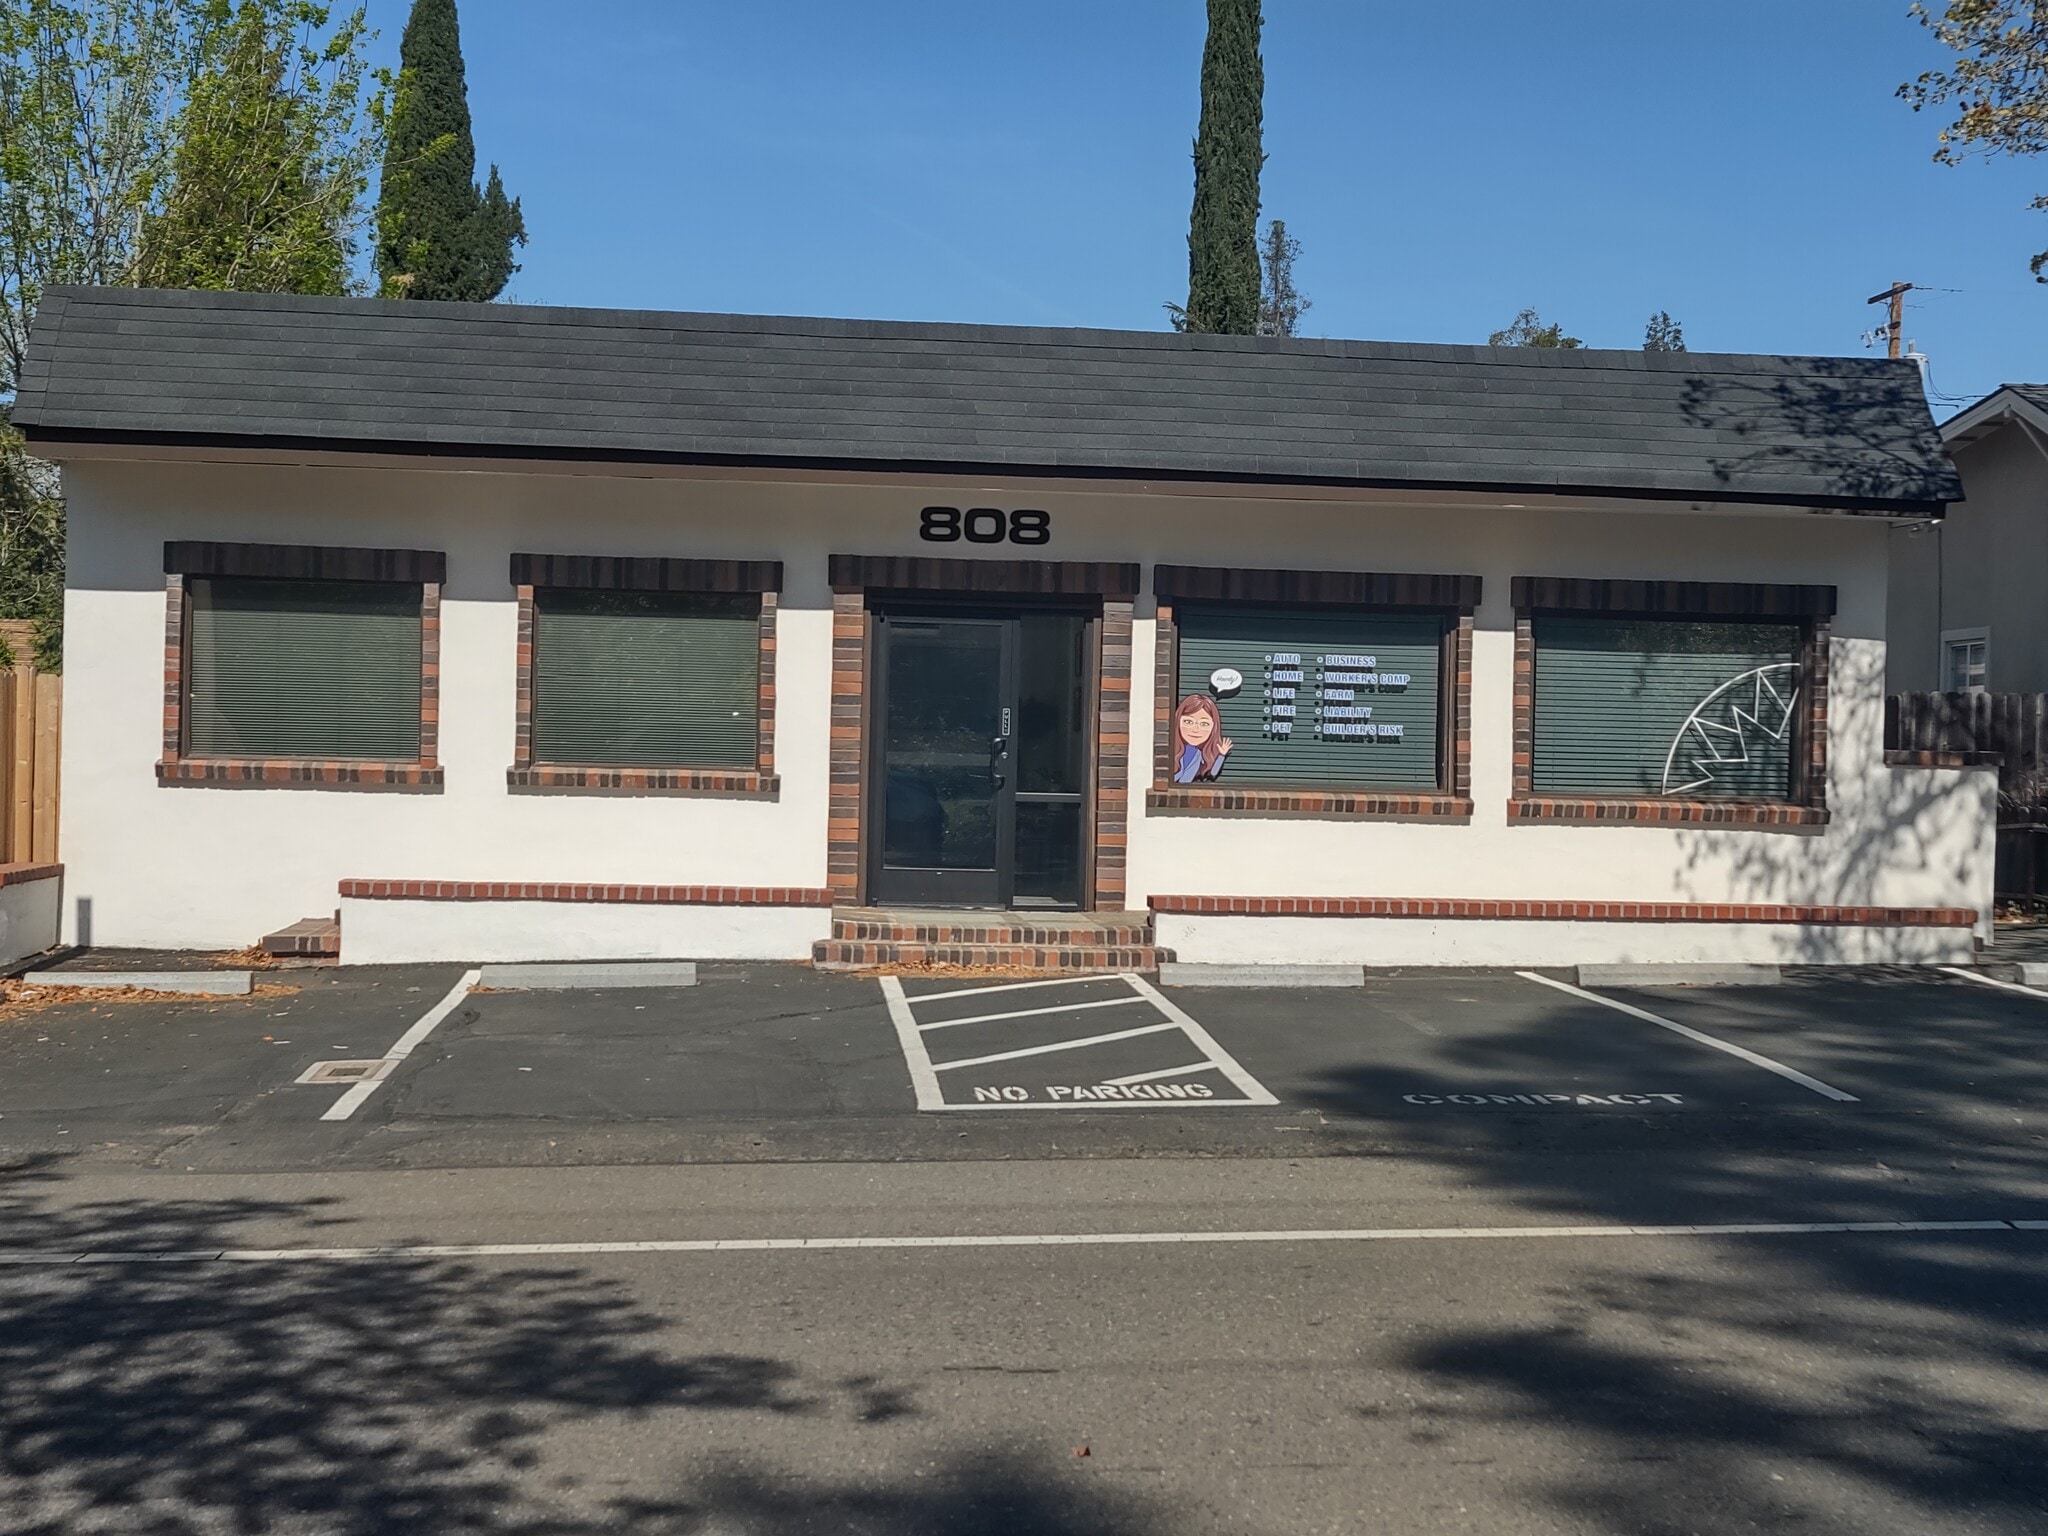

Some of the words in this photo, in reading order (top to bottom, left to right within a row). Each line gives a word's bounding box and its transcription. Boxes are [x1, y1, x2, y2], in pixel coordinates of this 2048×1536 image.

[919, 506, 1050, 545] 808
[1273, 653, 1300, 664] AUTO
[1326, 656, 1376, 666] BUSINESS
[1273, 671, 1303, 682] HOME
[1325, 673, 1377, 683] WORKER'S
[1380, 674, 1410, 685] COMP
[1273, 689, 1295, 699] LIFE
[1325, 690, 1354, 700] FARM
[1273, 706, 1296, 716] FIRE
[1324, 707, 1372, 718] LIABILITY
[1272, 723, 1292, 733] PET
[1324, 725, 1376, 735] BUILDER'S
[1379, 726, 1403, 736] RISK
[973, 1086, 1029, 1101] NO
[1046, 1084, 1213, 1100] PARKING
[1402, 1093, 1685, 1105] COMPACT
